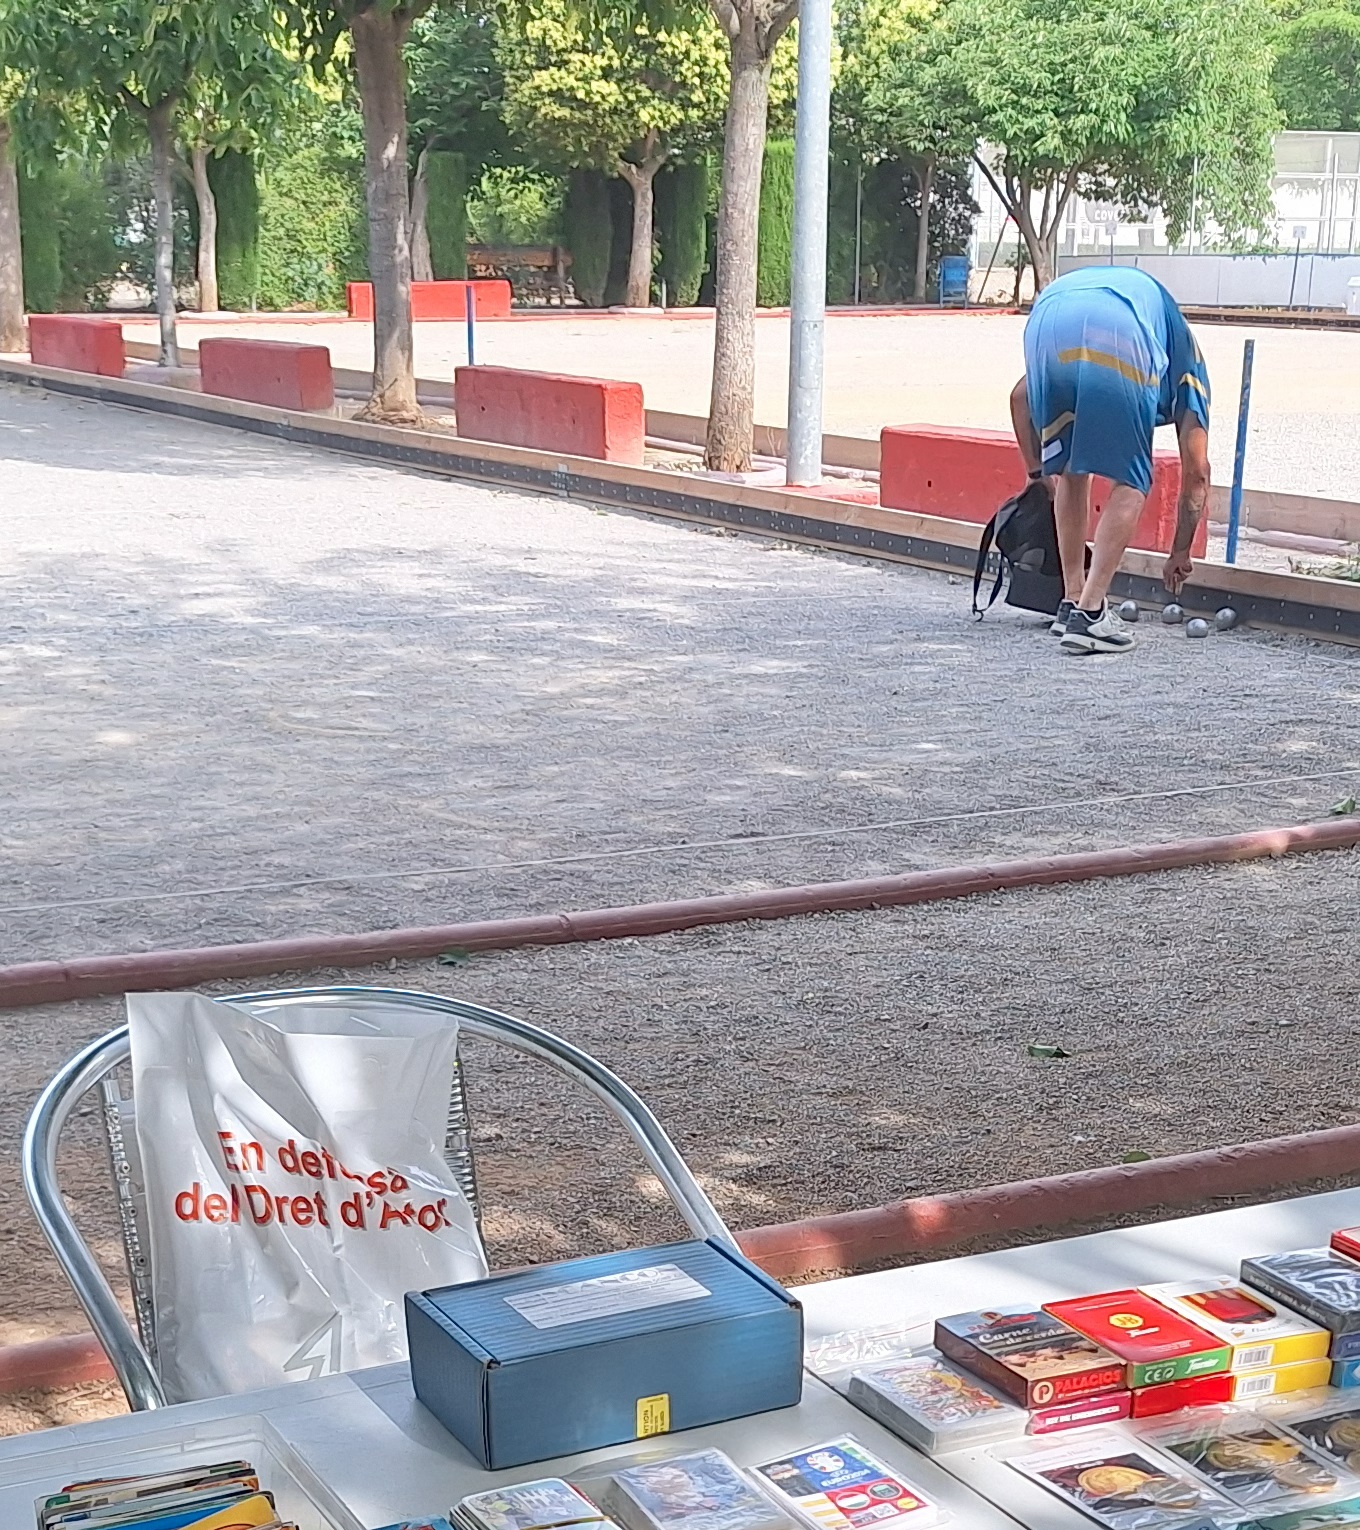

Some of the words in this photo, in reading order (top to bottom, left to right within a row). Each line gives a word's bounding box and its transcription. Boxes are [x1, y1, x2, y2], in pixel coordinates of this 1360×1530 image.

[217, 1131, 264, 1172] En
[175, 1182, 240, 1224] del
[244, 1184, 331, 1226] Dret
[978, 1326, 1034, 1344] Carne
[1055, 1369, 1122, 1393] PALACIOS
